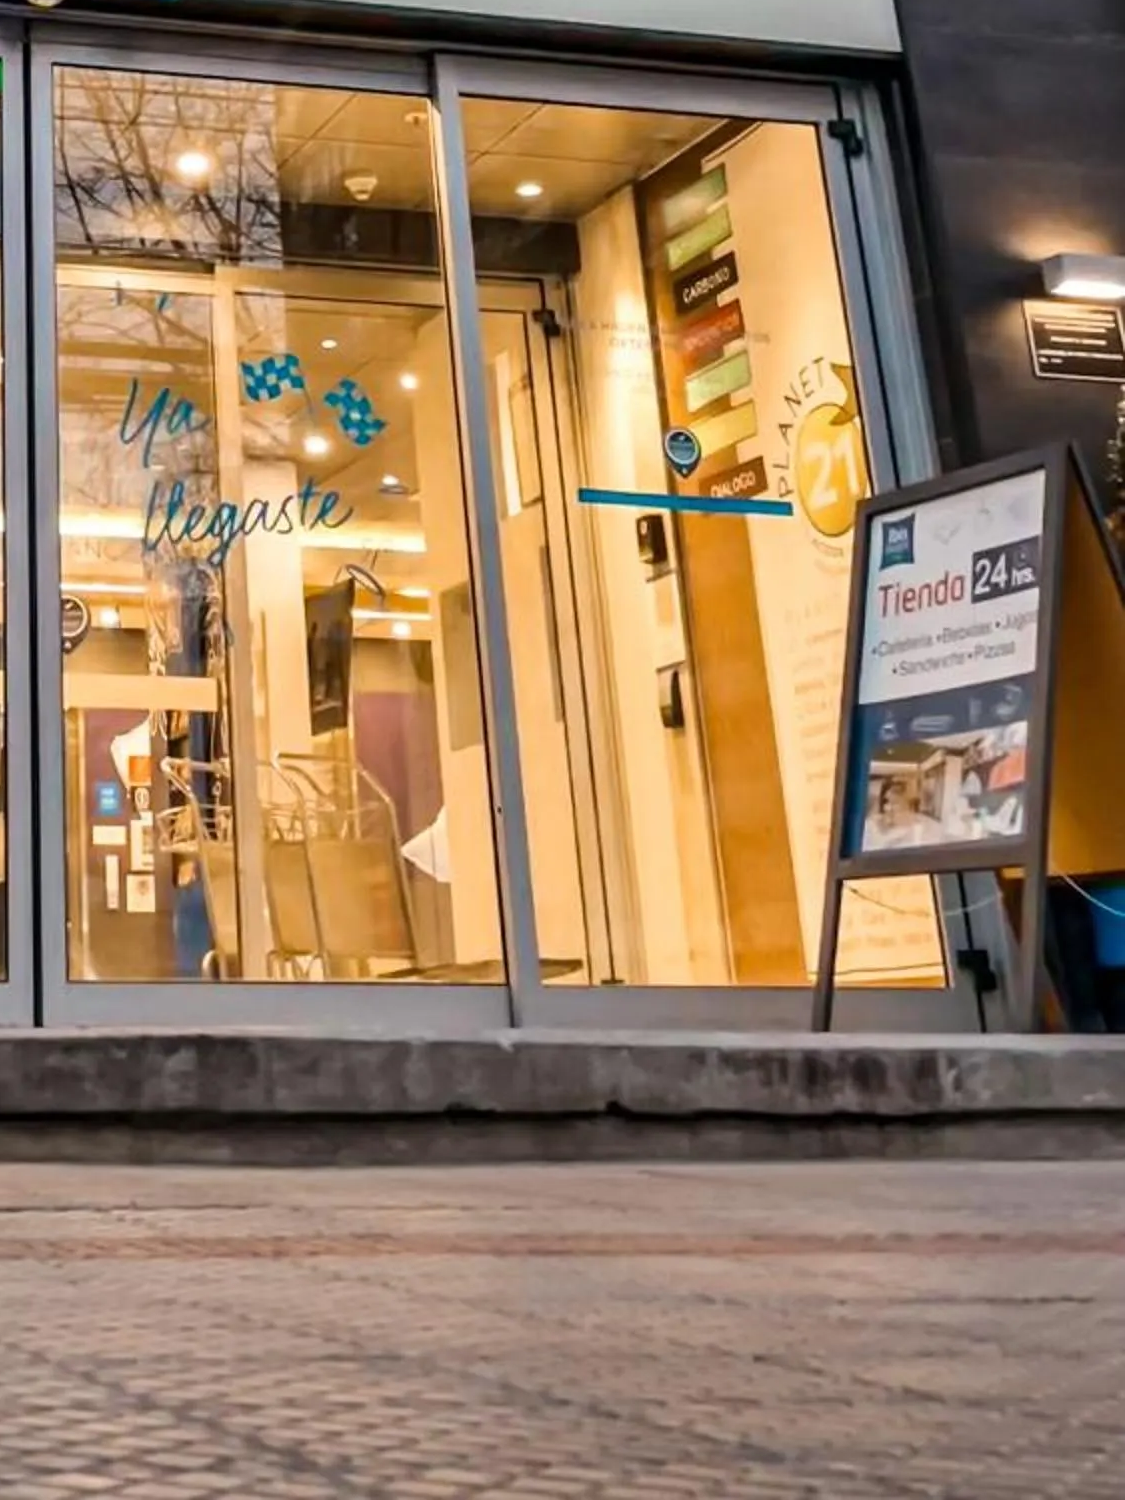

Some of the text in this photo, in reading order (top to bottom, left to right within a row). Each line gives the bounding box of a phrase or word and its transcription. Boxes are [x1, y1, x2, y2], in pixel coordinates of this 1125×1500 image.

[804, 429, 861, 514] 21
[142, 476, 354, 567] llegaste
[878, 571, 966, 618] Tienda
[974, 553, 1008, 595] 24
